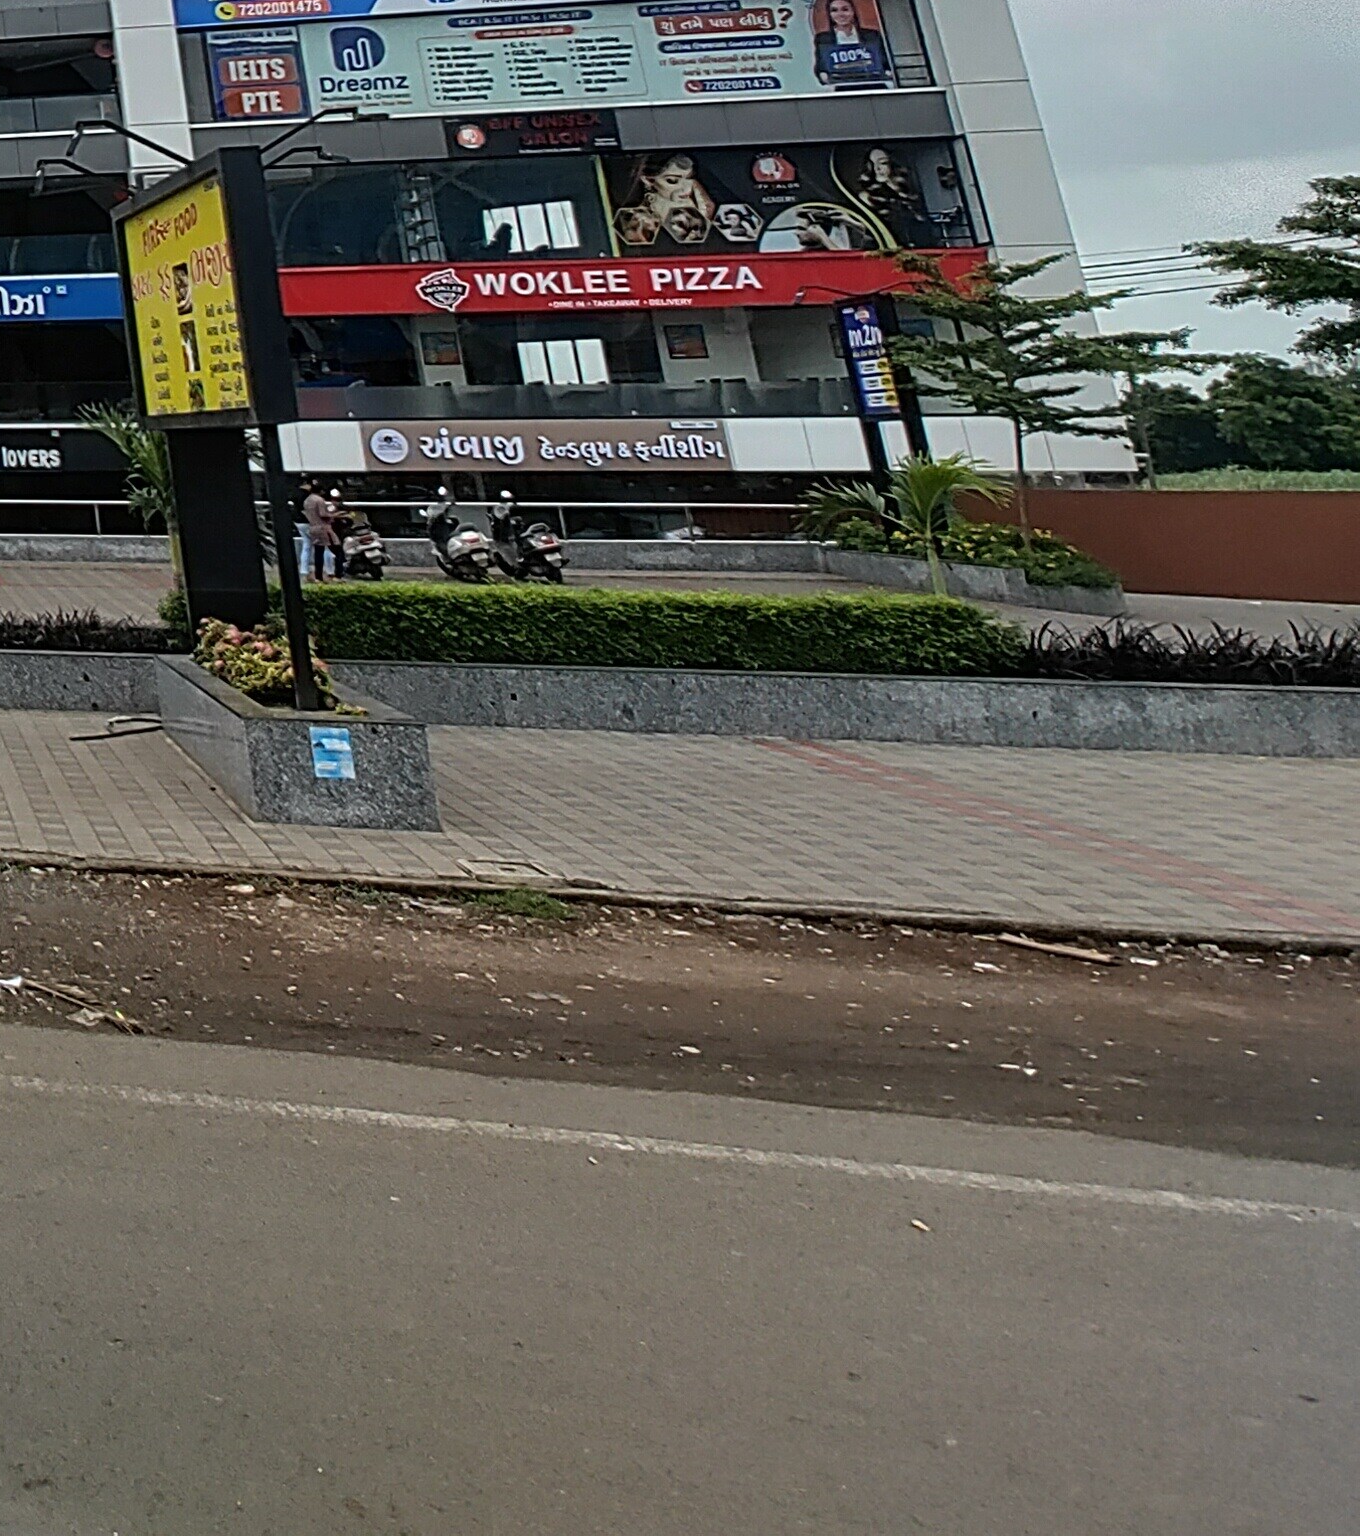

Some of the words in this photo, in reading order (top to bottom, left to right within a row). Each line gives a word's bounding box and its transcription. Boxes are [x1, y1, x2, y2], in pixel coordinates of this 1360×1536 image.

[238, 0, 323, 16] 7202001475
[680, 15, 704, 31] તમે
[708, 14, 733, 29] પણ
[830, 48, 871, 64] 100%
[228, 58, 286, 82] IELTS
[319, 75, 410, 93] Dreamz
[704, 78, 775, 91] 7202001475
[241, 90, 283, 114] PTE
[473, 269, 631, 296] WOKLEE
[650, 265, 763, 291] PIZZA
[593, 298, 640, 308] TAKEAWAY
[648, 297, 693, 307] DELIVERY
[419, 426, 526, 464] અંબાજી
[538, 434, 614, 466] હેન્ડલુમ
[617, 444, 631, 459] &
